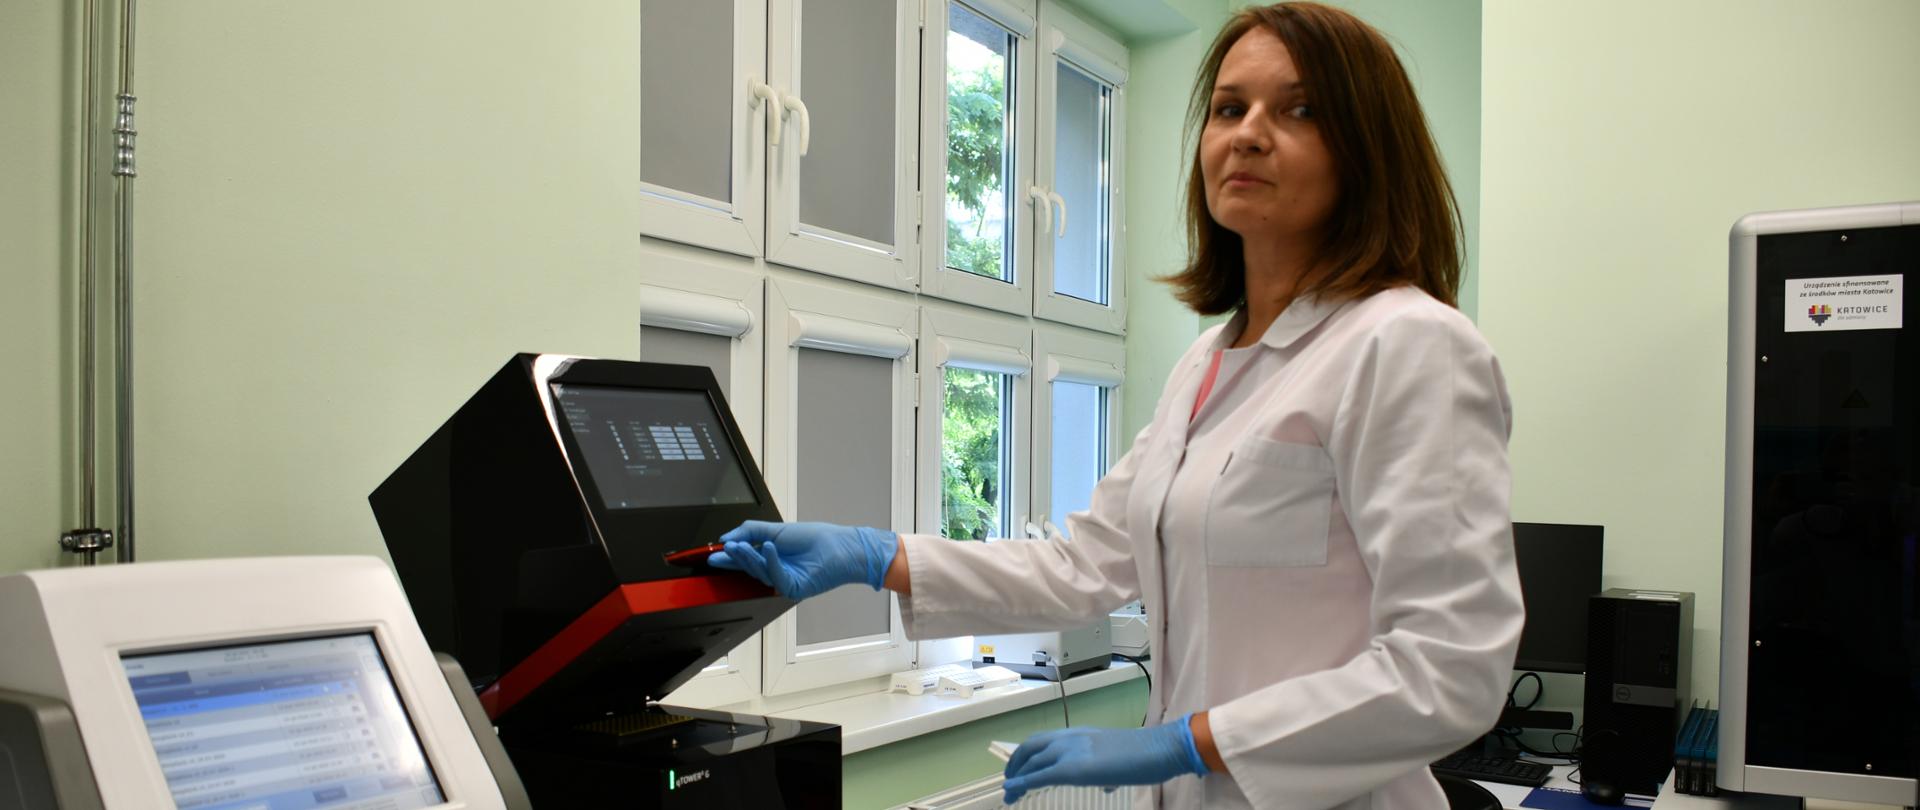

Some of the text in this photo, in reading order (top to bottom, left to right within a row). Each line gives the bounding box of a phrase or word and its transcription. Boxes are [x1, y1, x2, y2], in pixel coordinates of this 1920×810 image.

[1803, 279, 1890, 289] Urządzenie sfinansowane
[1837, 305, 1888, 314] KATOWICE
